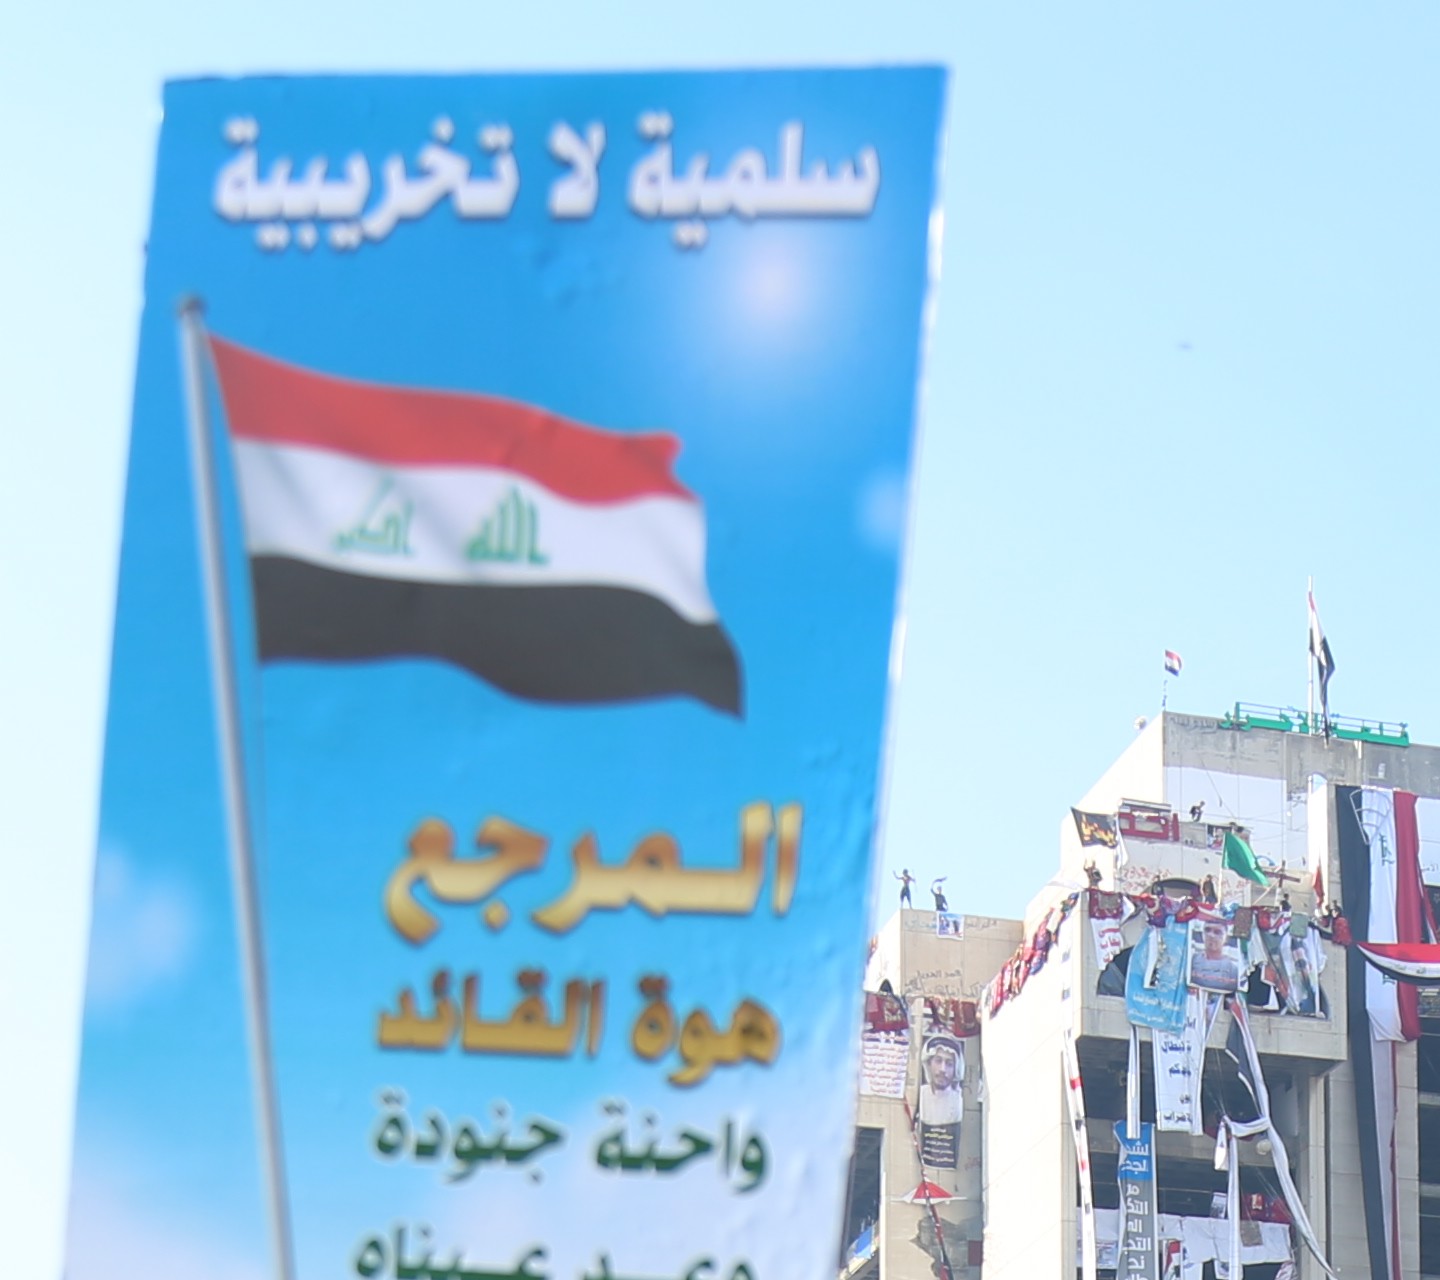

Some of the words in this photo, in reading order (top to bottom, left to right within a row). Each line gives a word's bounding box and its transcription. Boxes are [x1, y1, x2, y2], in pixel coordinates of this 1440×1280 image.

[211, 115, 522, 251] تخريبية
[549, 122, 606, 220] لا
[626, 113, 883, 248] سلمية
[384, 798, 805, 945] المرجع
[376, 969, 610, 1058] القائد
[633, 972, 784, 1090] هوة
[371, 1086, 566, 1184] جنودة
[594, 1098, 774, 1196] واحنة
